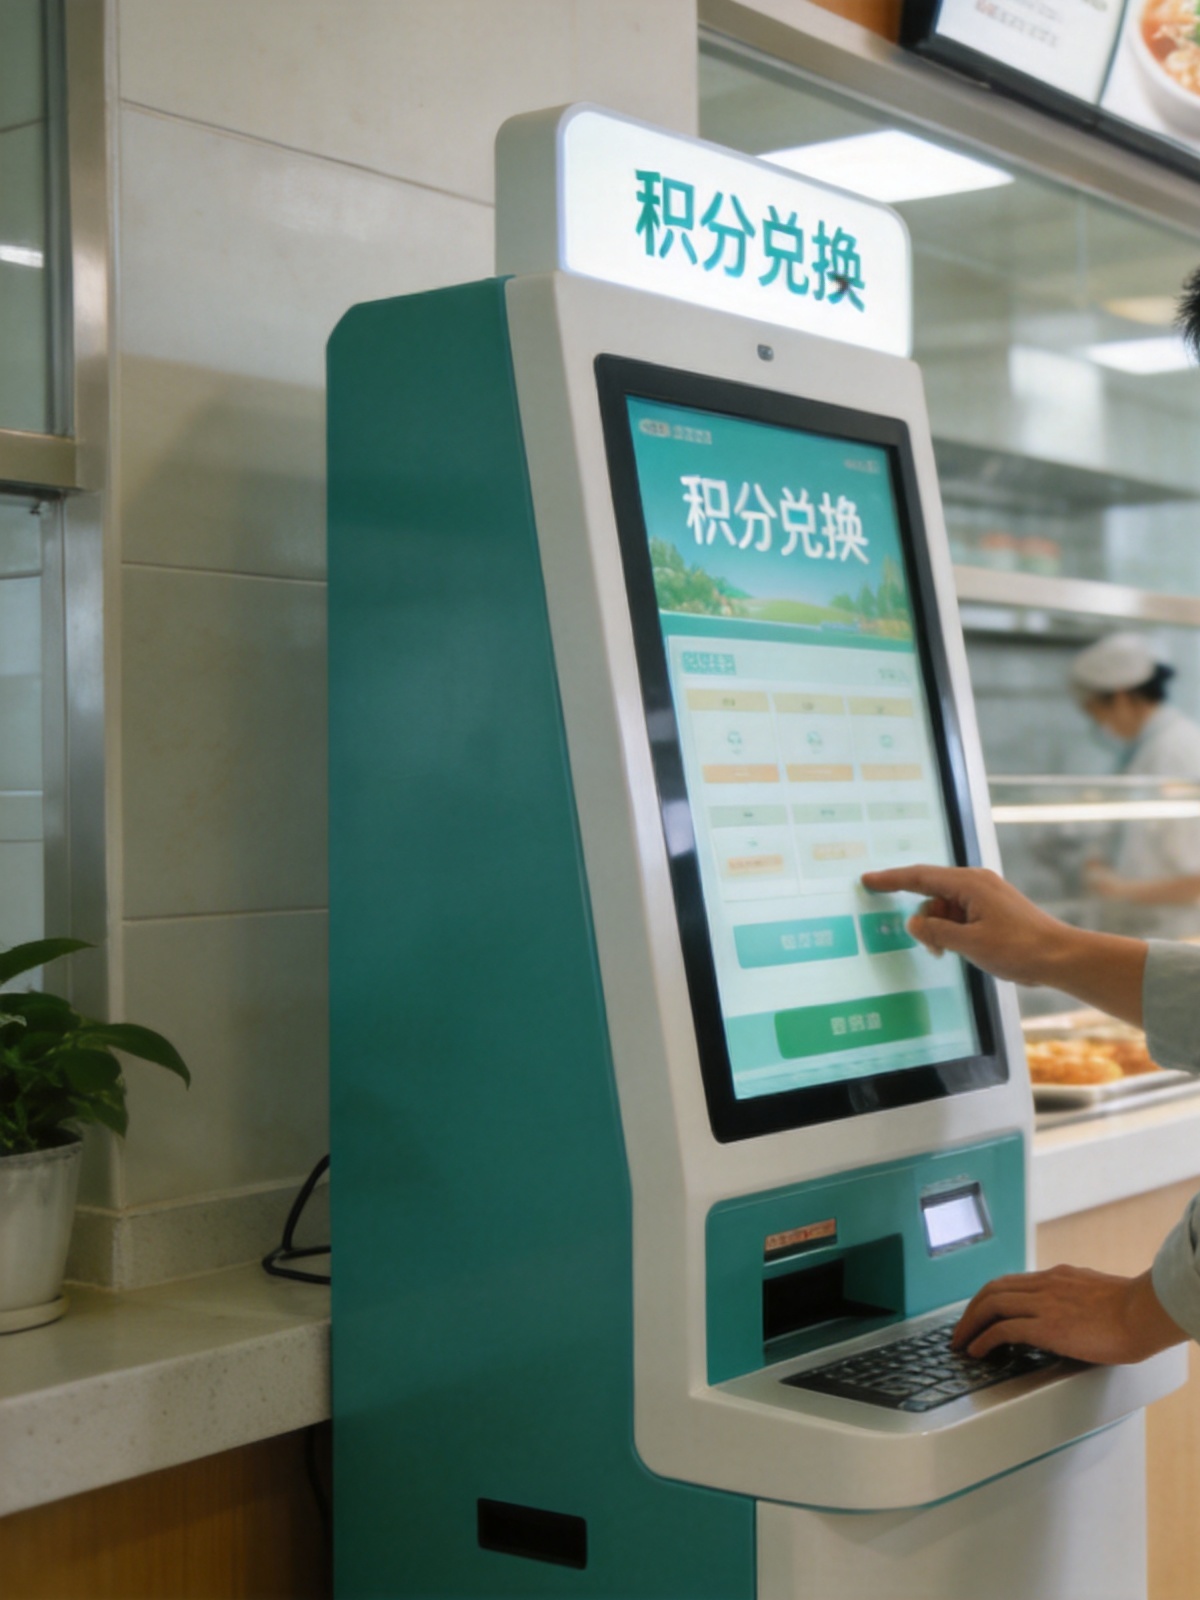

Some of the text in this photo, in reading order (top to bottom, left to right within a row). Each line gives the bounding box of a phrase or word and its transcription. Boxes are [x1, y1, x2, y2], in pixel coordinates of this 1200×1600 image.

[634, 168, 866, 313] 积分兑换
[680, 474, 870, 565] 积分兑换
